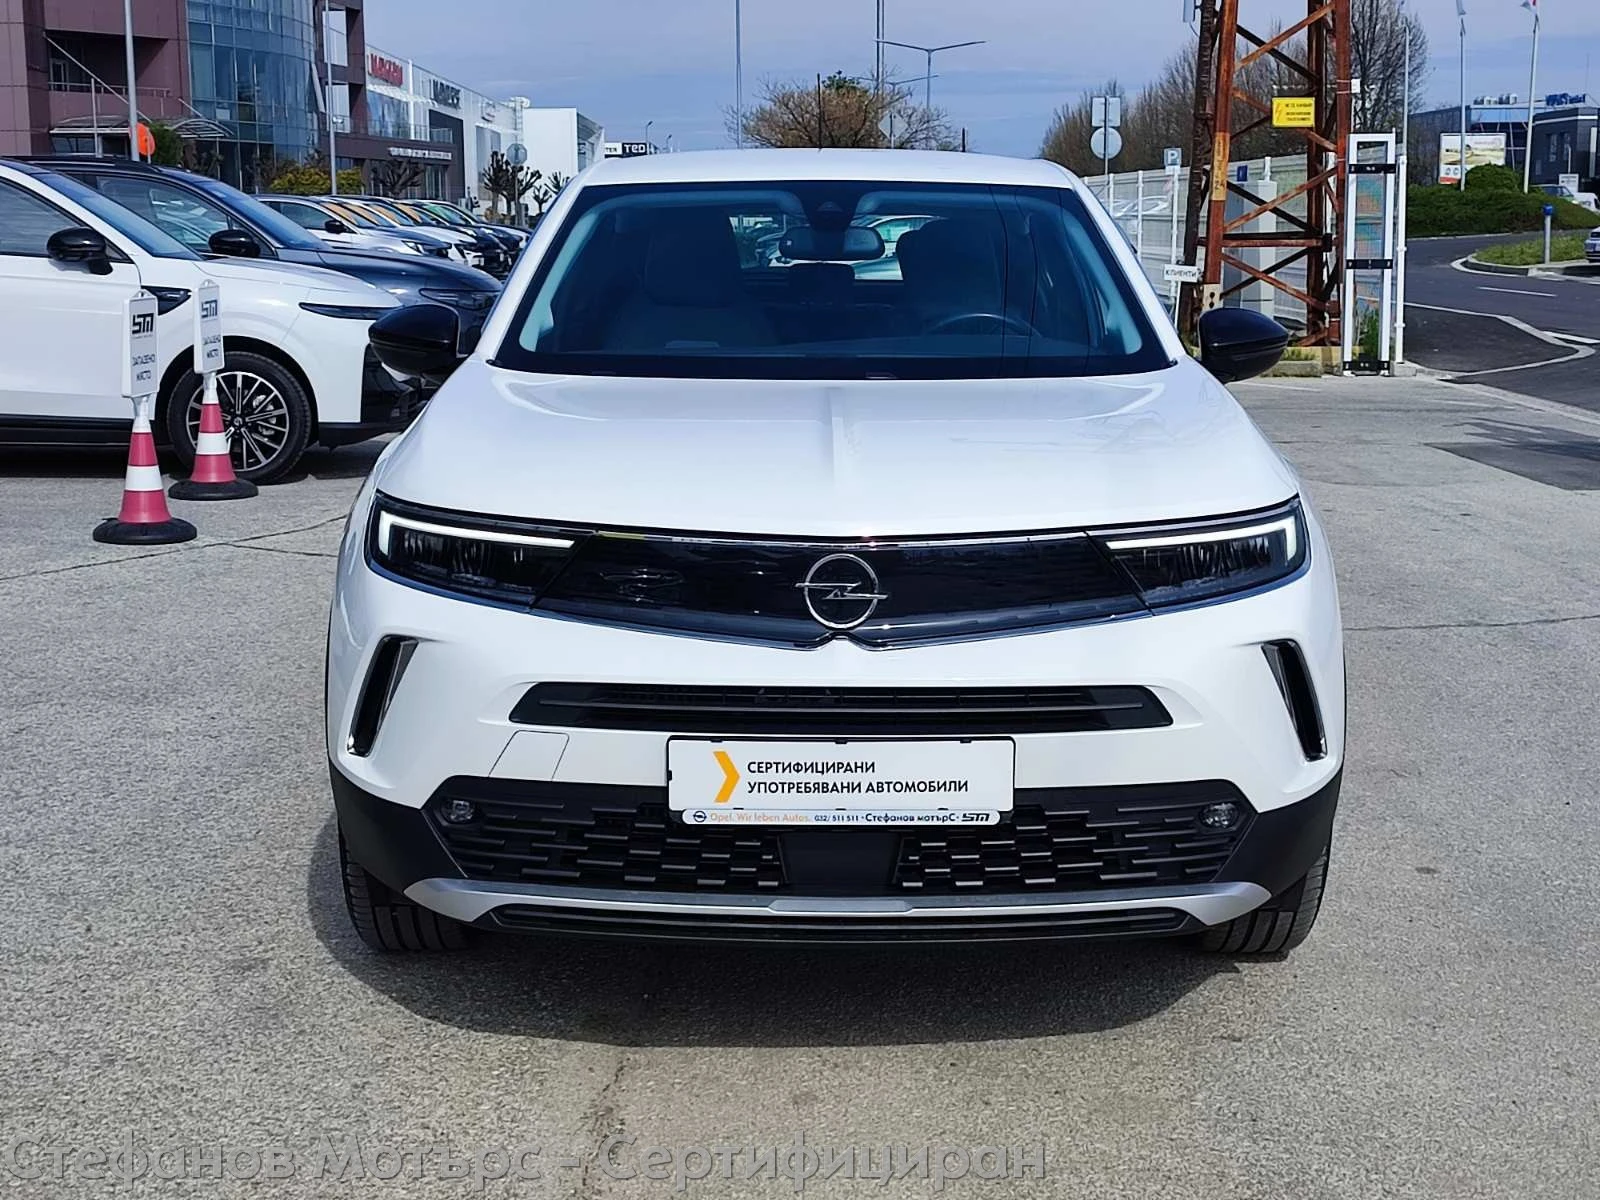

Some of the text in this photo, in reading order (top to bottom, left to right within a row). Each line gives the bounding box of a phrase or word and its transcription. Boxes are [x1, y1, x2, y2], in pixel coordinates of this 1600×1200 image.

[1167, 150, 1178, 165] P
[747, 761, 875, 776] СЕРТИФИЦИРАНИ
[747, 780, 969, 795] УПОТРЕБЯВАНИ АВТОМОБИЛИ
[736, 813, 752, 822] Wir
[754, 812, 780, 822] leben
